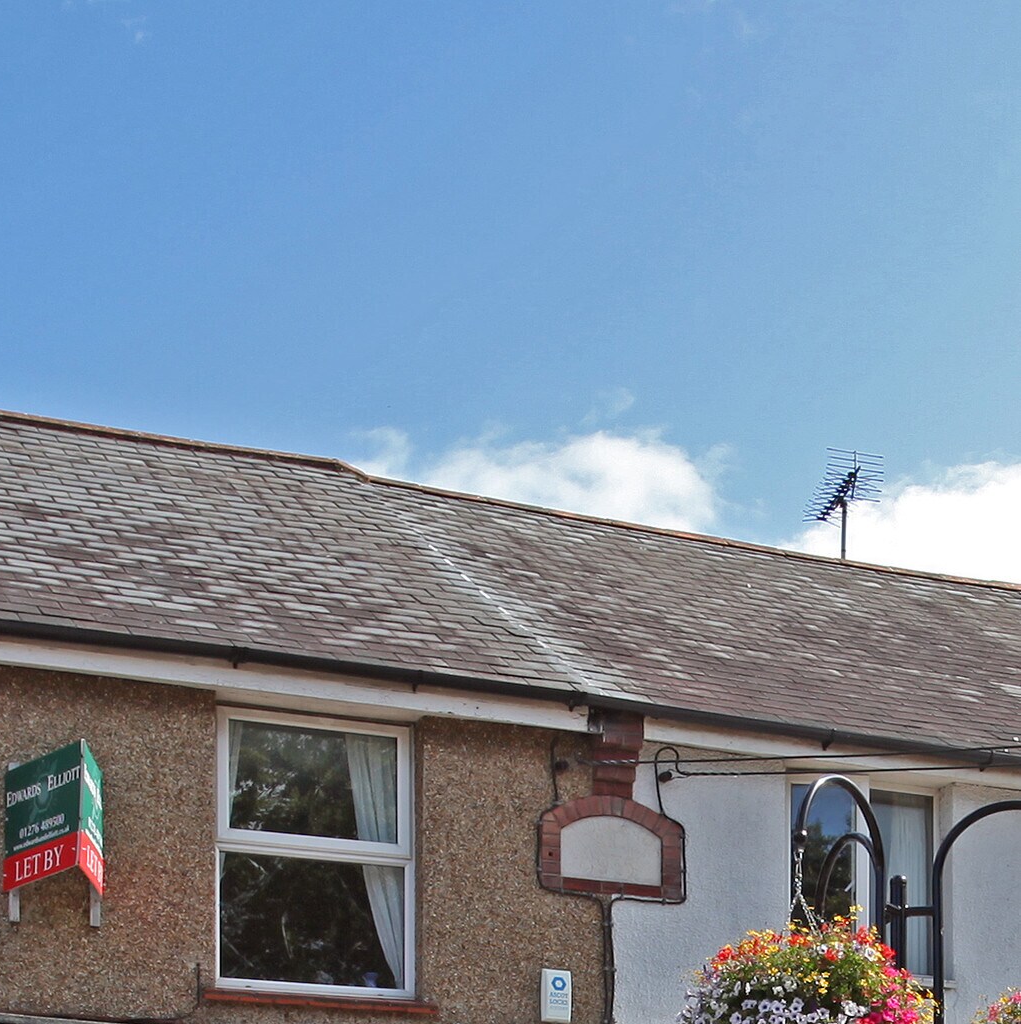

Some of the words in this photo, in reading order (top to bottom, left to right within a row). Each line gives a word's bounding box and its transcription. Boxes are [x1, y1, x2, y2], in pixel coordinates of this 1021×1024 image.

[6, 782, 42, 808] EDWARDS
[47, 766, 81, 792] ELLIOTT
[15, 851, 41, 882] LET
[44, 845, 64, 871] BY
